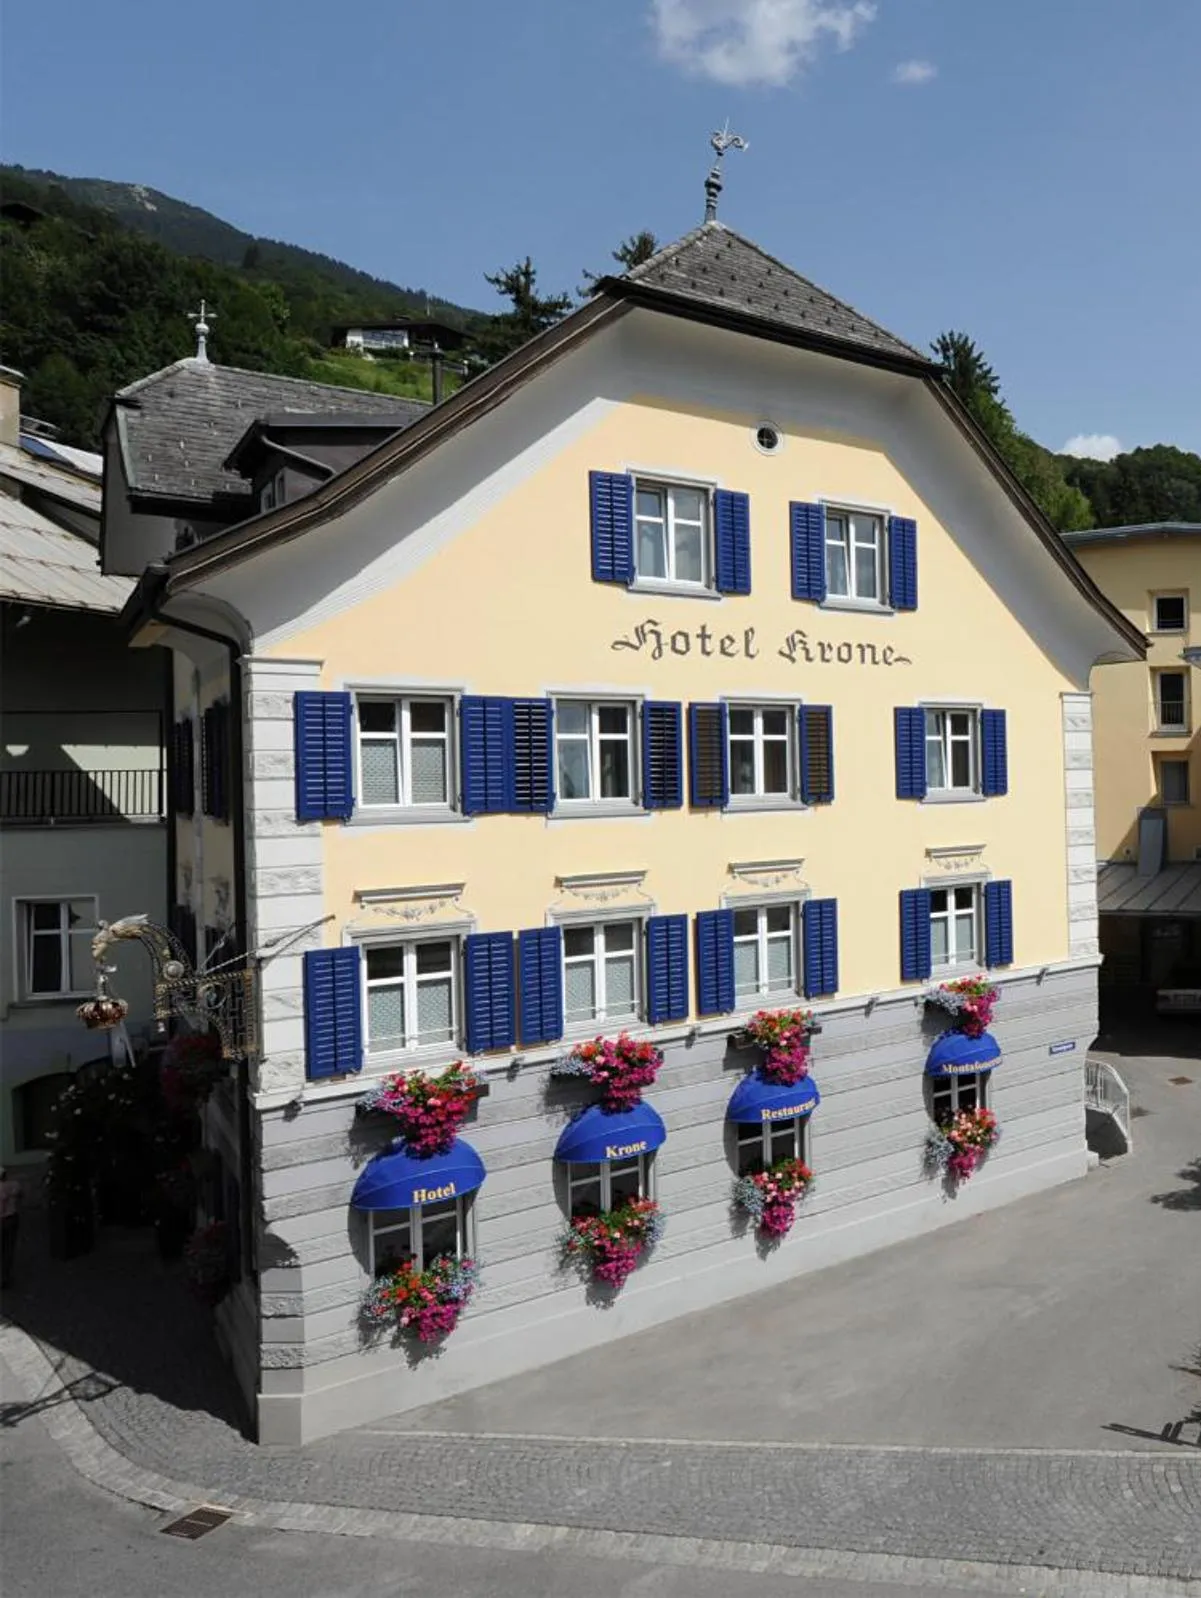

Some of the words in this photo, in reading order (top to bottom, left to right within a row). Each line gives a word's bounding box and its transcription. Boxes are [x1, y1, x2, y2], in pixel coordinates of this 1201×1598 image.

[610, 619, 759, 661] Hotel
[778, 629, 912, 666] Krone
[760, 1097, 816, 1120] Restaurant
[605, 1140, 648, 1158] Krone
[413, 1182, 456, 1203] Hotel
